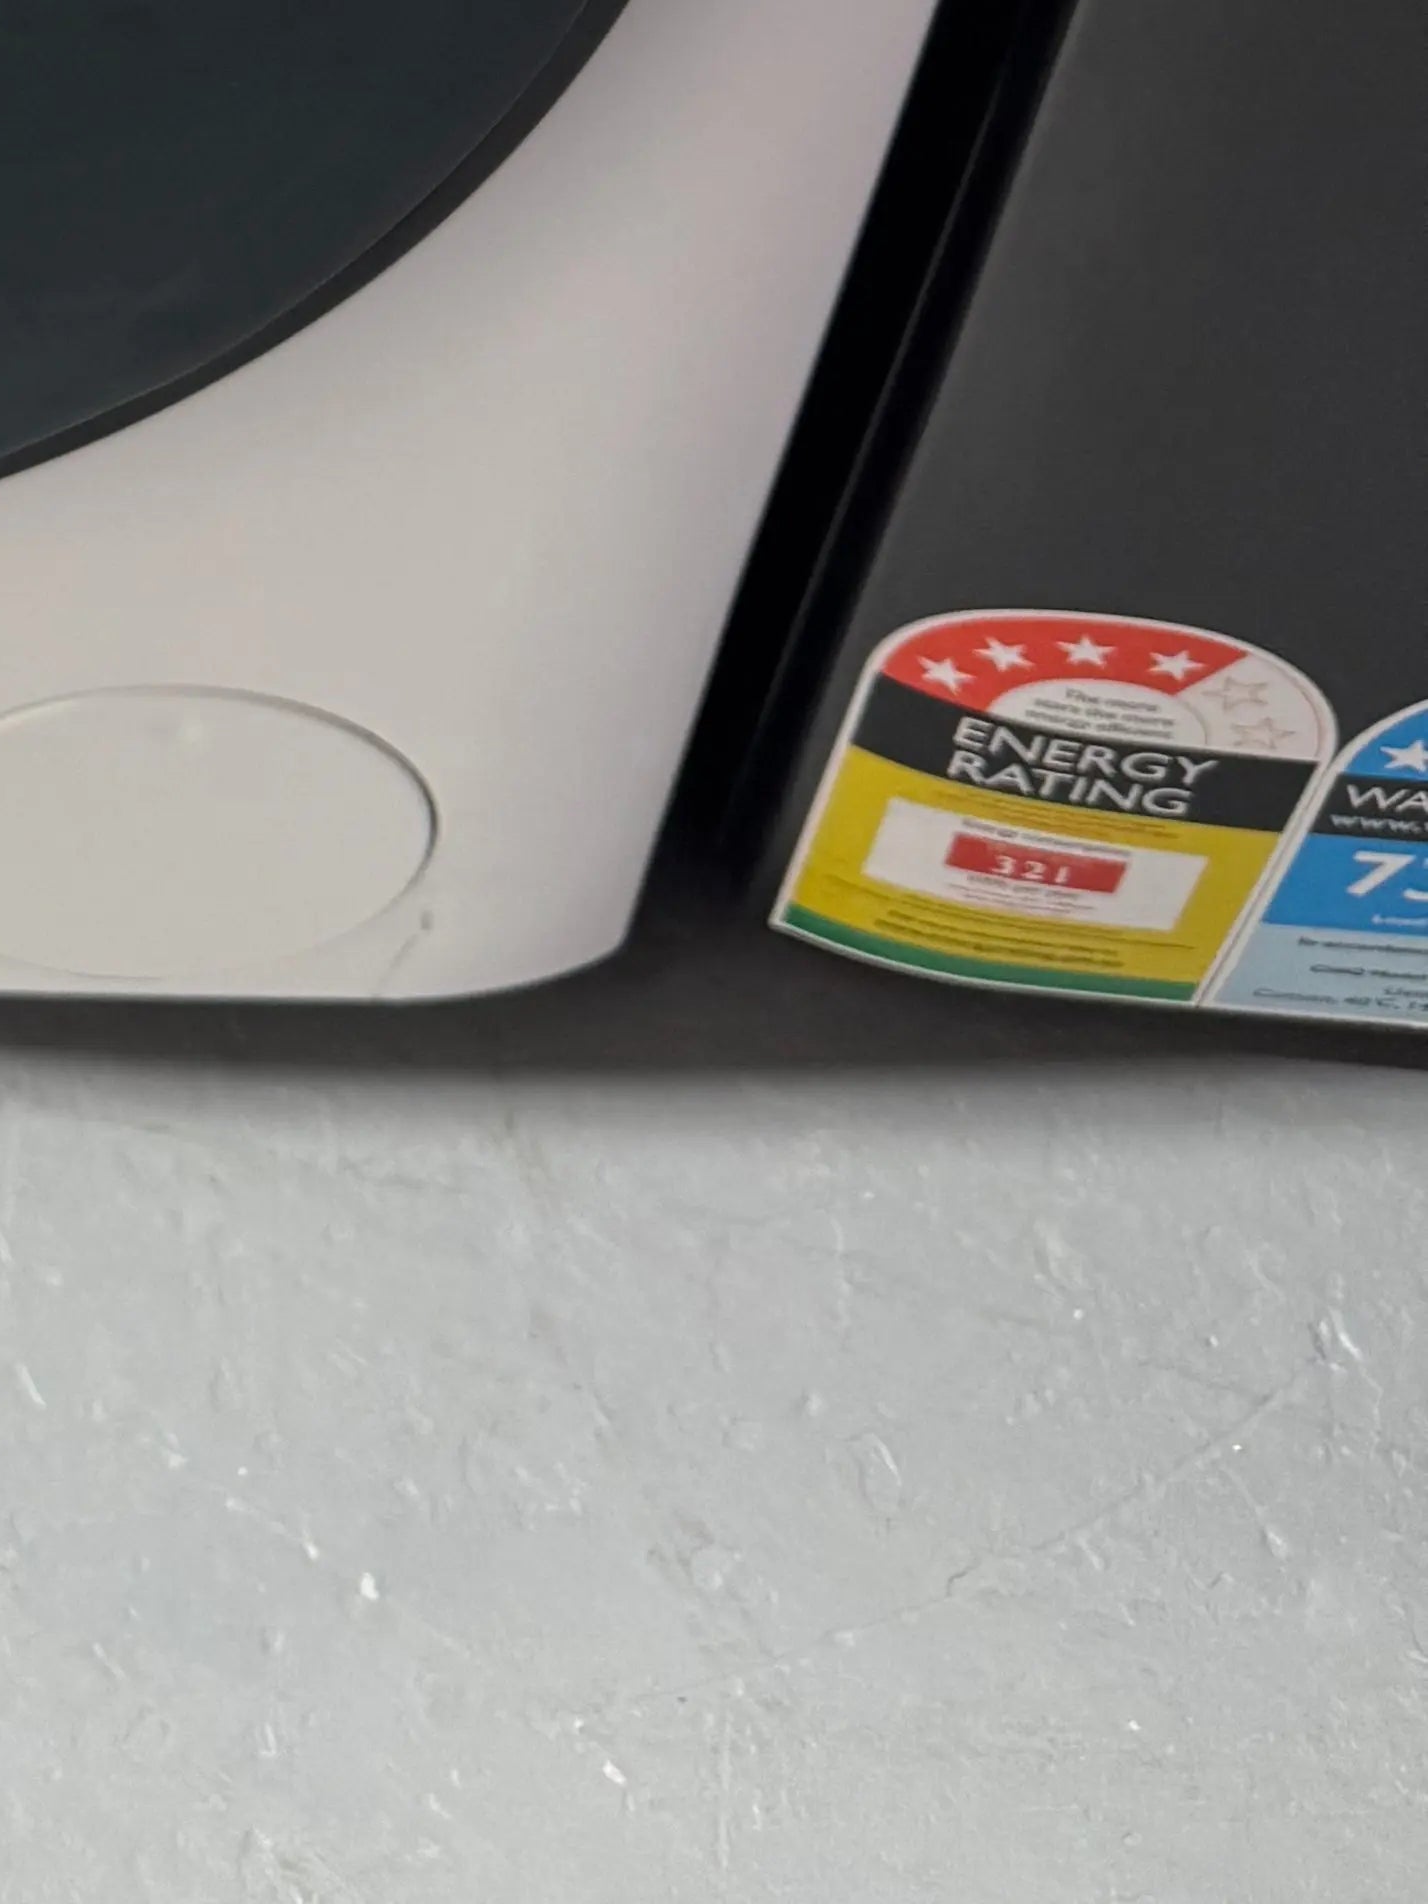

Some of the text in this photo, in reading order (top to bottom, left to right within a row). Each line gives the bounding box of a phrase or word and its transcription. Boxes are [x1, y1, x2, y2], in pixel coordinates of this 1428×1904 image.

[946, 749, 1194, 816] RATING
[952, 715, 1221, 784] ENERGY
[991, 855, 1072, 884] 321
